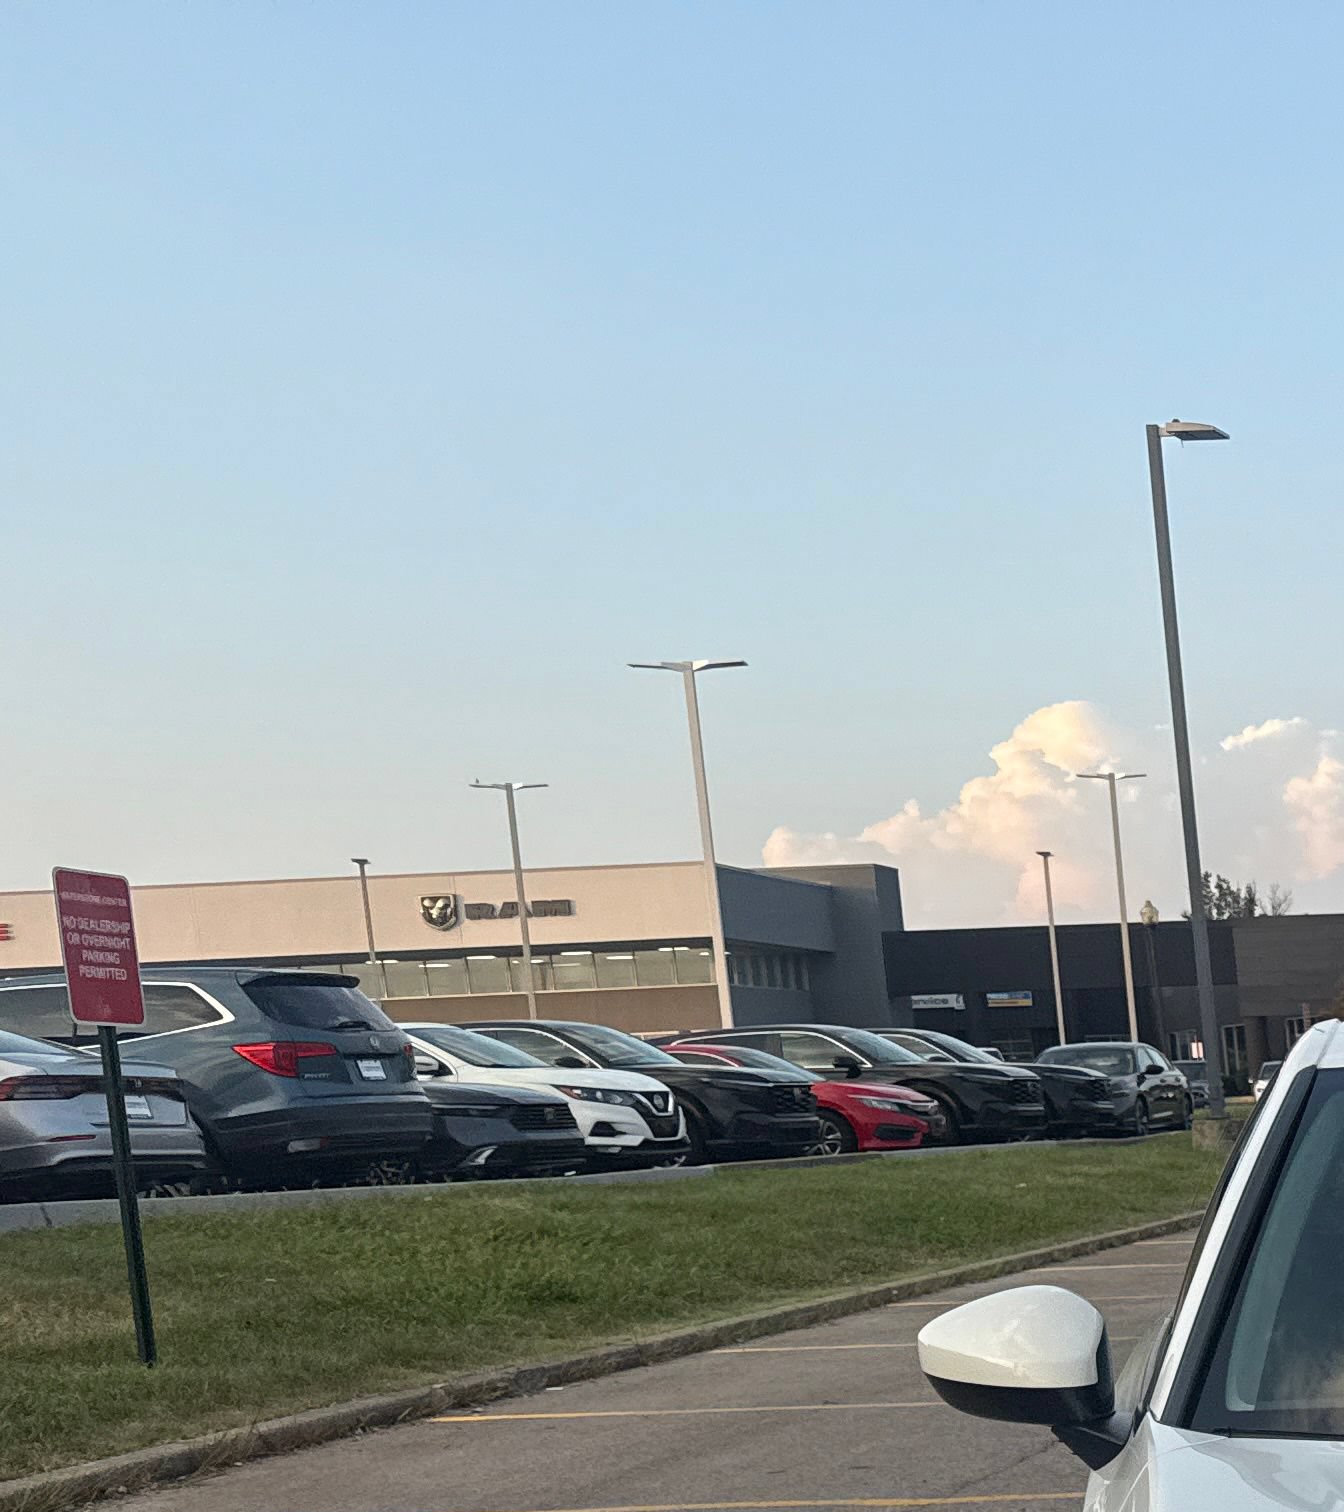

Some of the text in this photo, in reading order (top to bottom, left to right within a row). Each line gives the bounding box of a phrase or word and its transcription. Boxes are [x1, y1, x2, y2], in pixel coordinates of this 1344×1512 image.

[464, 900, 571, 920] RAM
[63, 916, 130, 933] NO DEALERSHIP
[67, 932, 130, 950] OR OVERNIGHT
[82, 950, 120, 965] PARKING
[79, 966, 127, 980] PERMITTED
